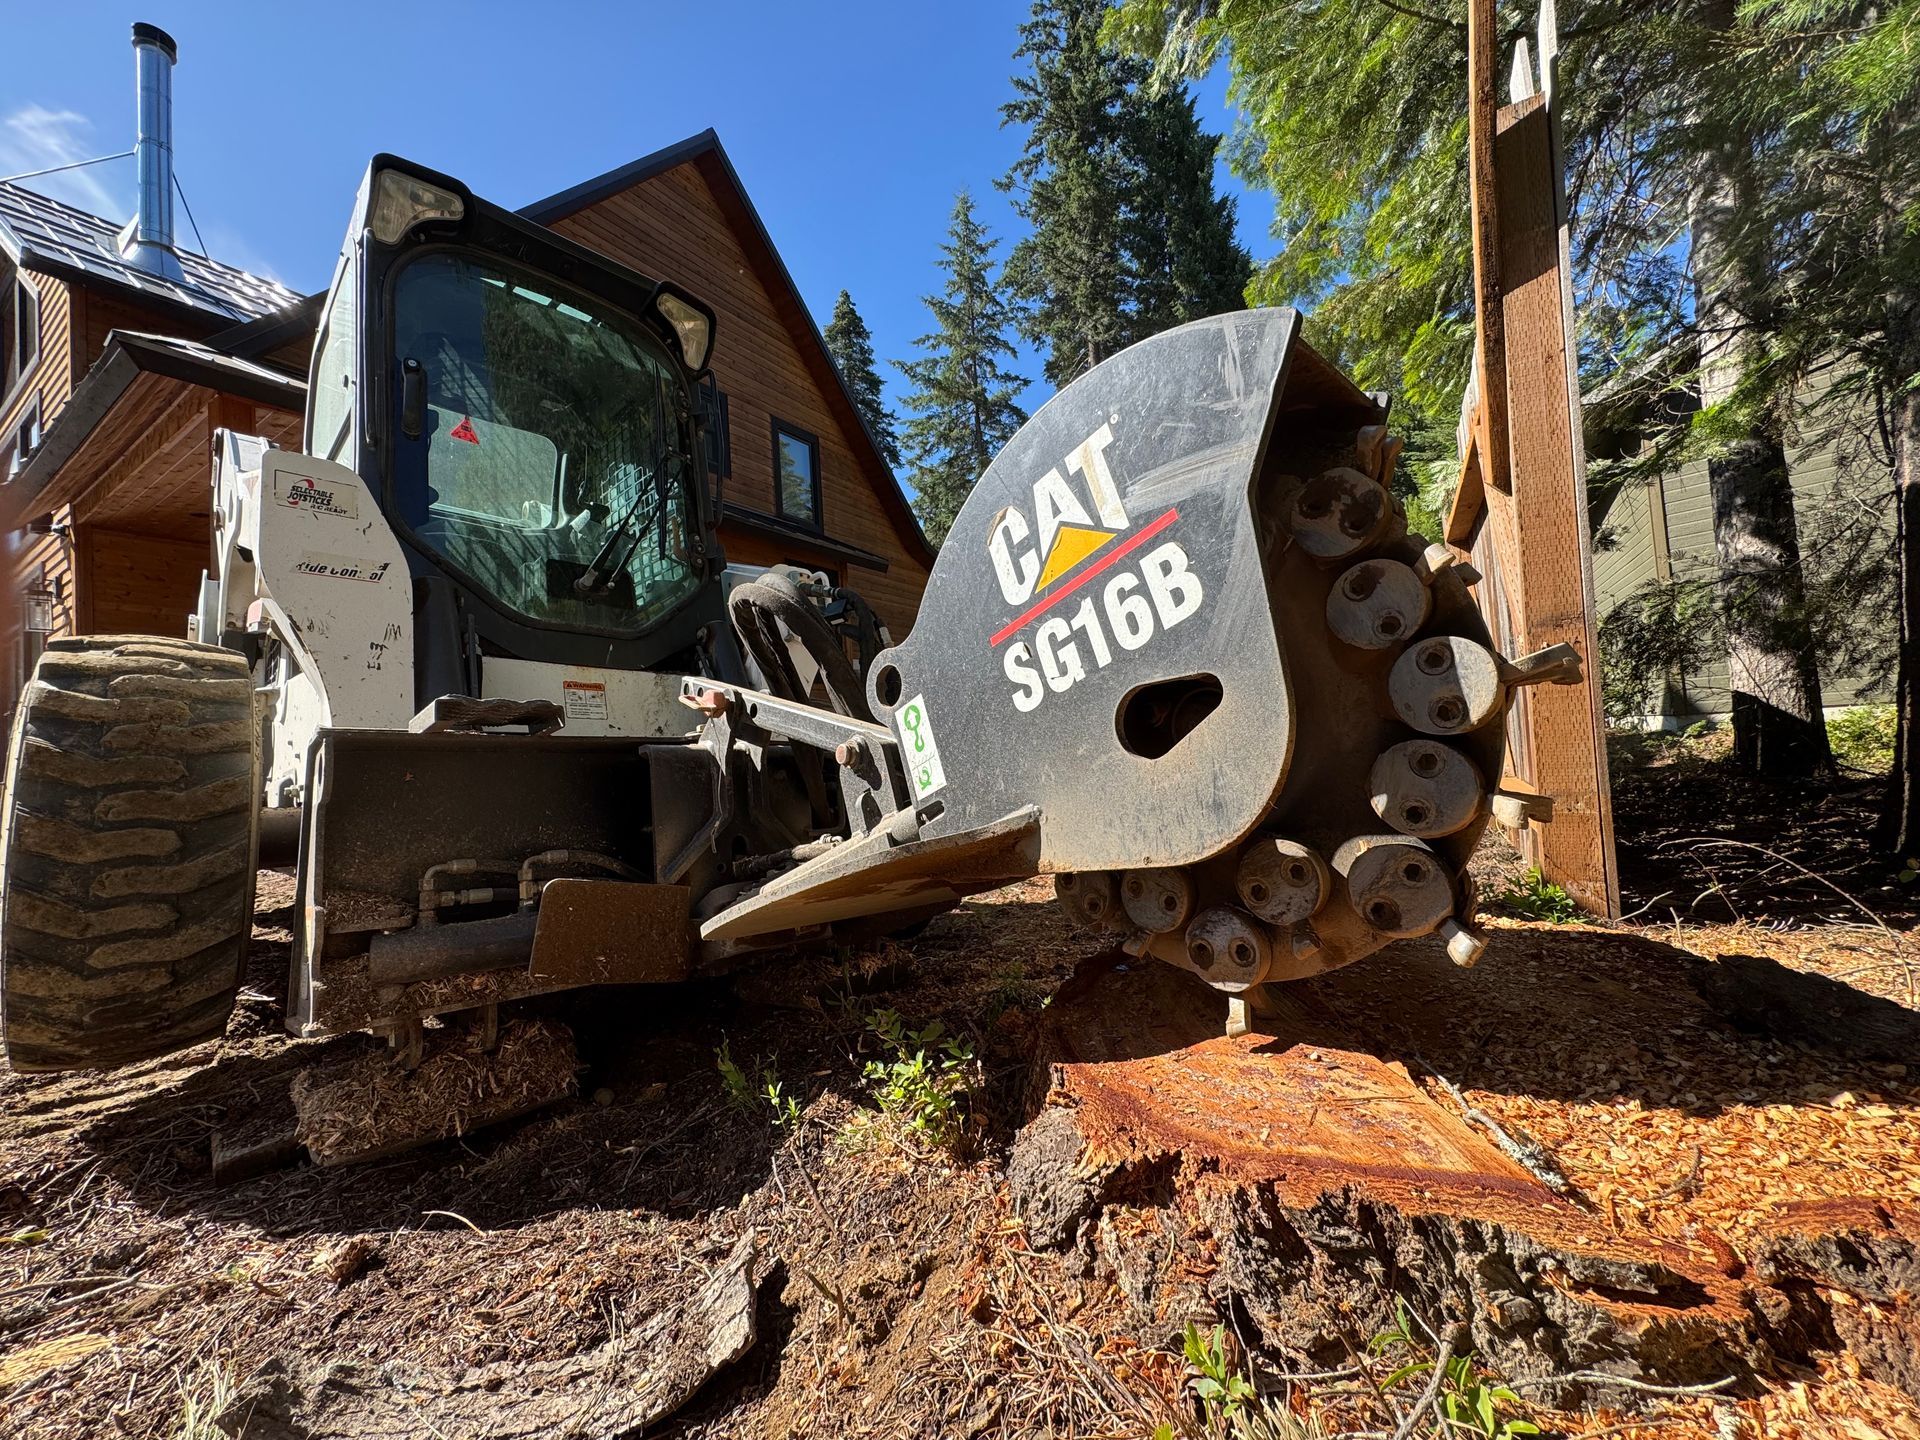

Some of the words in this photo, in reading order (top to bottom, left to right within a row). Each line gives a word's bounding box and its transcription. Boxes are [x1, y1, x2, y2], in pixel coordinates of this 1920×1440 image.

[287, 491, 333, 506] JOYSTICKS
[291, 485, 334, 499] SELECTABLE
[987, 421, 1130, 606] CAT
[1003, 541, 1202, 713] SG16B
